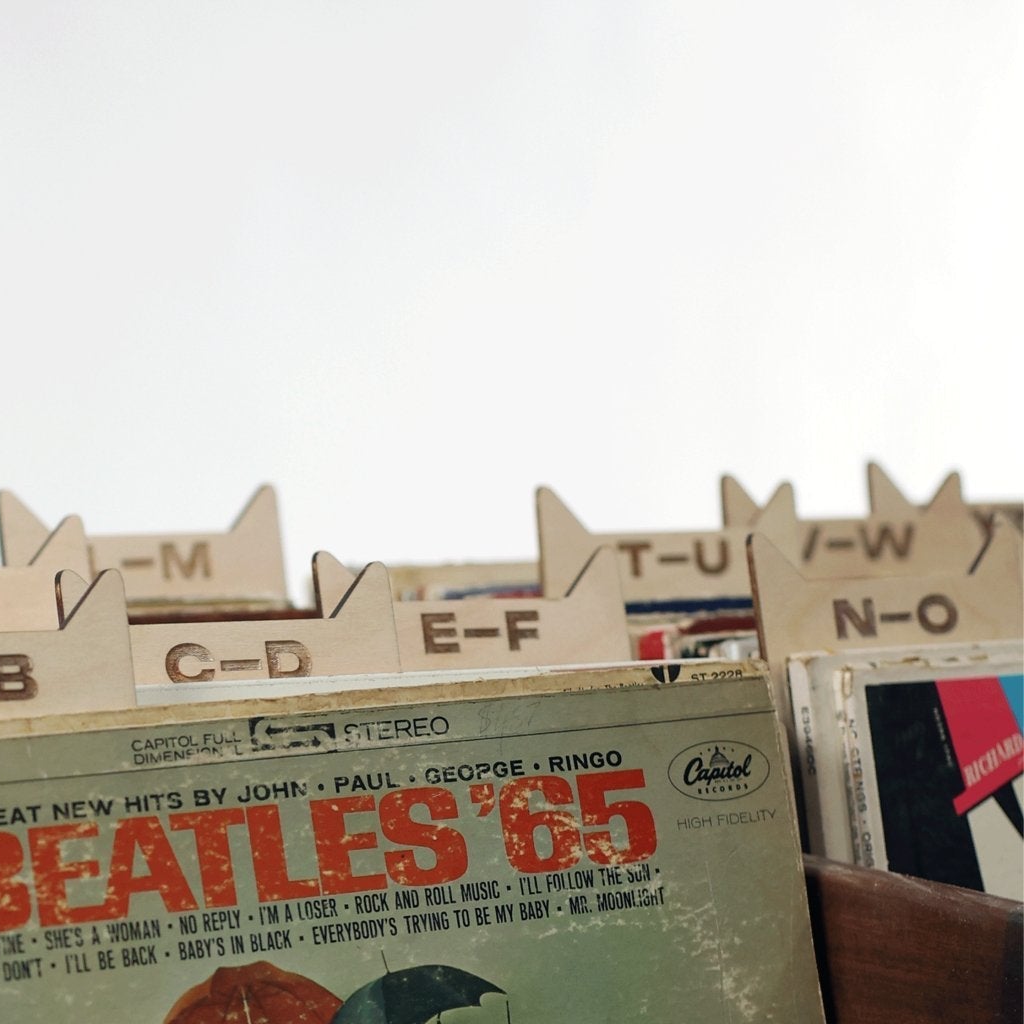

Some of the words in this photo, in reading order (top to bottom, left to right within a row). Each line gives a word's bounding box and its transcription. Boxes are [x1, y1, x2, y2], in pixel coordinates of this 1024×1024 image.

[87, 541, 214, 581] -M
[617, 538, 730, 578] T-U
[421, 610, 540, 654] E-F
[832, 593, 959, 640] N-O
[165, 639, 313, 683] C-D
[131, 735, 198, 752] CAPITOL
[203, 731, 242, 745] FULL
[343, 716, 450, 744] STEREO
[133, 745, 243, 765] DIMENSIONL
[683, 754, 752, 786] Capitol
[53, 799, 114, 821] NEW
[124, 791, 183, 813] HITS
[194, 787, 227, 807] BY
[238, 781, 308, 804] JOHN
[334, 772, 400, 794] PAUL
[425, 760, 525, 784] GEORGE
[548, 750, 623, 773] RINGO
[697, 783, 749, 795] RECORDS
[677, 816, 713, 831] HIGH
[717, 808, 777, 827] FIDELITY
[44, 928, 84, 951] SHE'S
[91, 928, 101, 945] A
[106, 920, 161, 943] WOMAN
[179, 915, 198, 936] NO
[203, 910, 241, 932] REPLY
[258, 906, 279, 926] I'M
[285, 905, 294, 923] A
[297, 899, 339, 921] LOSER
[354, 893, 388, 915] ROCK
[395, 890, 420, 911] AND
[425, 885, 456, 906] ROLL
[460, 880, 501, 903] MUSIC
[518, 875, 542, 896] I'LL
[546, 869, 594, 893] FOLLOW
[598, 867, 622, 887] THE
[626, 863, 651, 883] SUN
[2, 958, 43, 983] DON'T
[64, 953, 91, 974] I'LL
[97, 951, 116, 971] BE
[122, 945, 158, 968] BACK
[179, 937, 225, 961] BABY'S
[230, 935, 245, 955] IN
[250, 930, 292, 953] BLACK
[312, 917, 398, 946] EVERYBODY'S
[403, 911, 450, 935] TRYING
[453, 908, 471, 929] TO
[475, 906, 492, 927] BE
[495, 903, 515, 924] MY
[520, 899, 551, 921] BABY
[569, 896, 593, 916] MR.
[596, 886, 666, 911] MOONLIGHT
